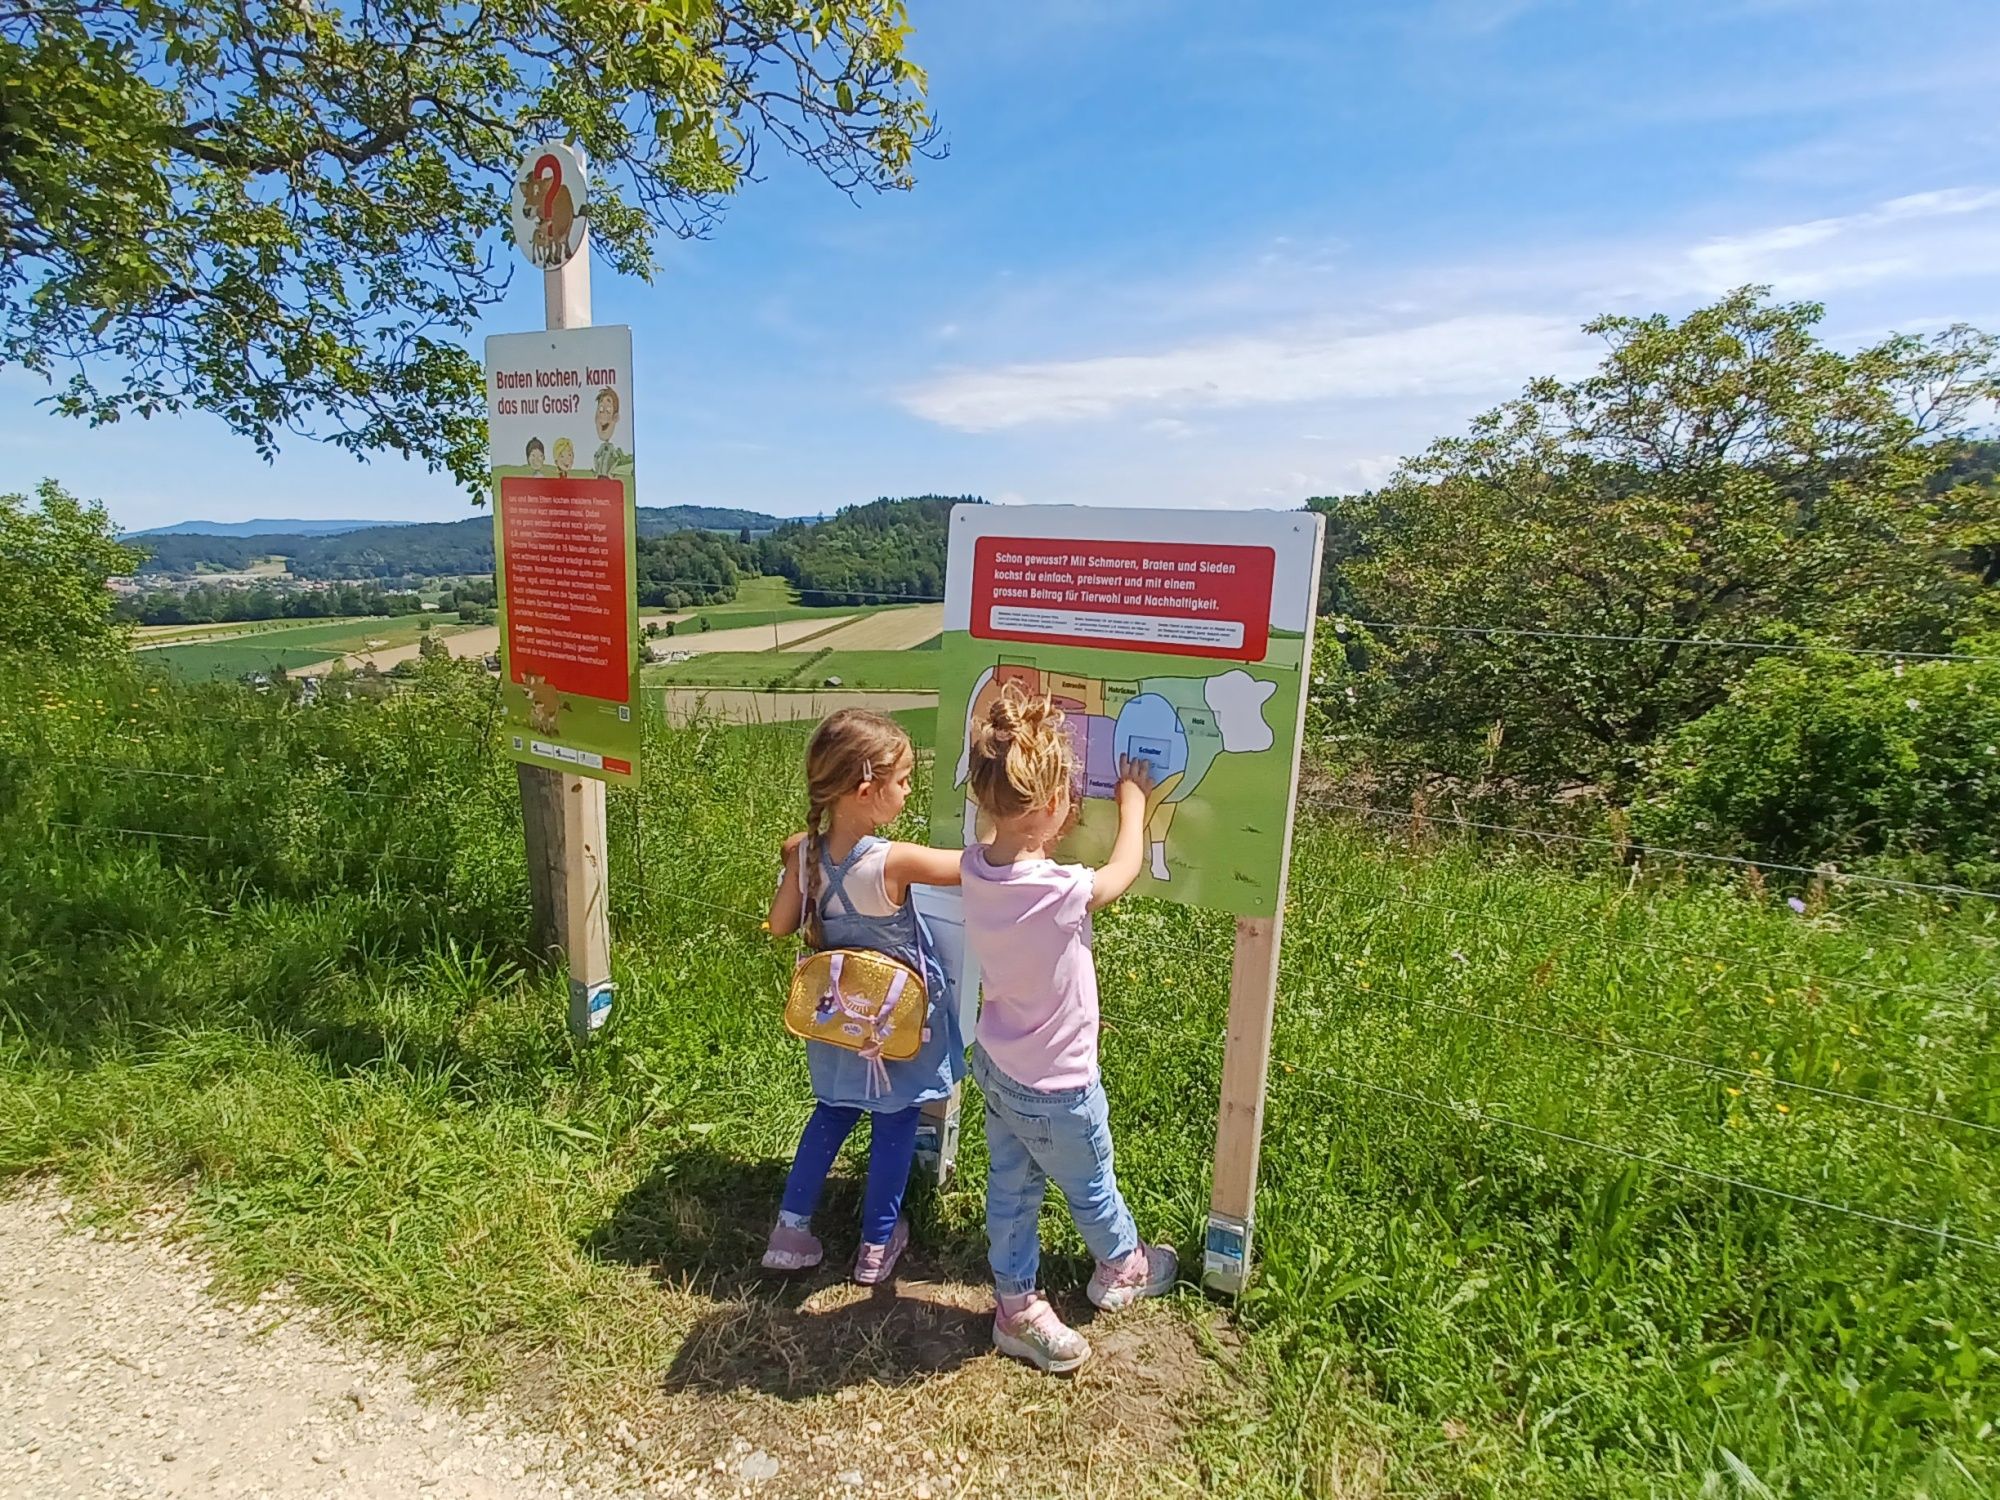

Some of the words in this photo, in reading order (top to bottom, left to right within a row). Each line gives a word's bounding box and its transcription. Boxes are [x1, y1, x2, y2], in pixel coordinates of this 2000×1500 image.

[496, 371, 532, 389] Braten
[536, 368, 582, 389] kochen,
[586, 366, 616, 385] kann
[498, 397, 518, 414] das
[521, 399, 539, 413] nur
[542, 394, 580, 413] Grosi?
[995, 552, 1022, 563] Schon
[1025, 555, 1068, 566] gewusst?
[1071, 556, 1085, 566] Mit
[1088, 557, 1138, 570] Schmoren,
[1142, 559, 1174, 571] Braten
[1178, 561, 1196, 571] und
[1199, 561, 1235, 574] Sieden
[994, 569, 1022, 580] kochst
[1025, 570, 1036, 581] du
[1038, 572, 1074, 584] einfach,
[1077, 574, 1122, 586] preiswert
[1125, 576, 1142, 587] und
[1145, 577, 1161, 588] mit
[1164, 578, 1195, 590] einem
[993, 587, 1028, 598] grossen
[1030, 588, 1062, 602] Beitrag
[1065, 589, 1078, 601] für
[1081, 591, 1120, 604] Tierwohl
[1124, 594, 1141, 605] und
[1144, 595, 1219, 611] Nachhaltigkeit.
